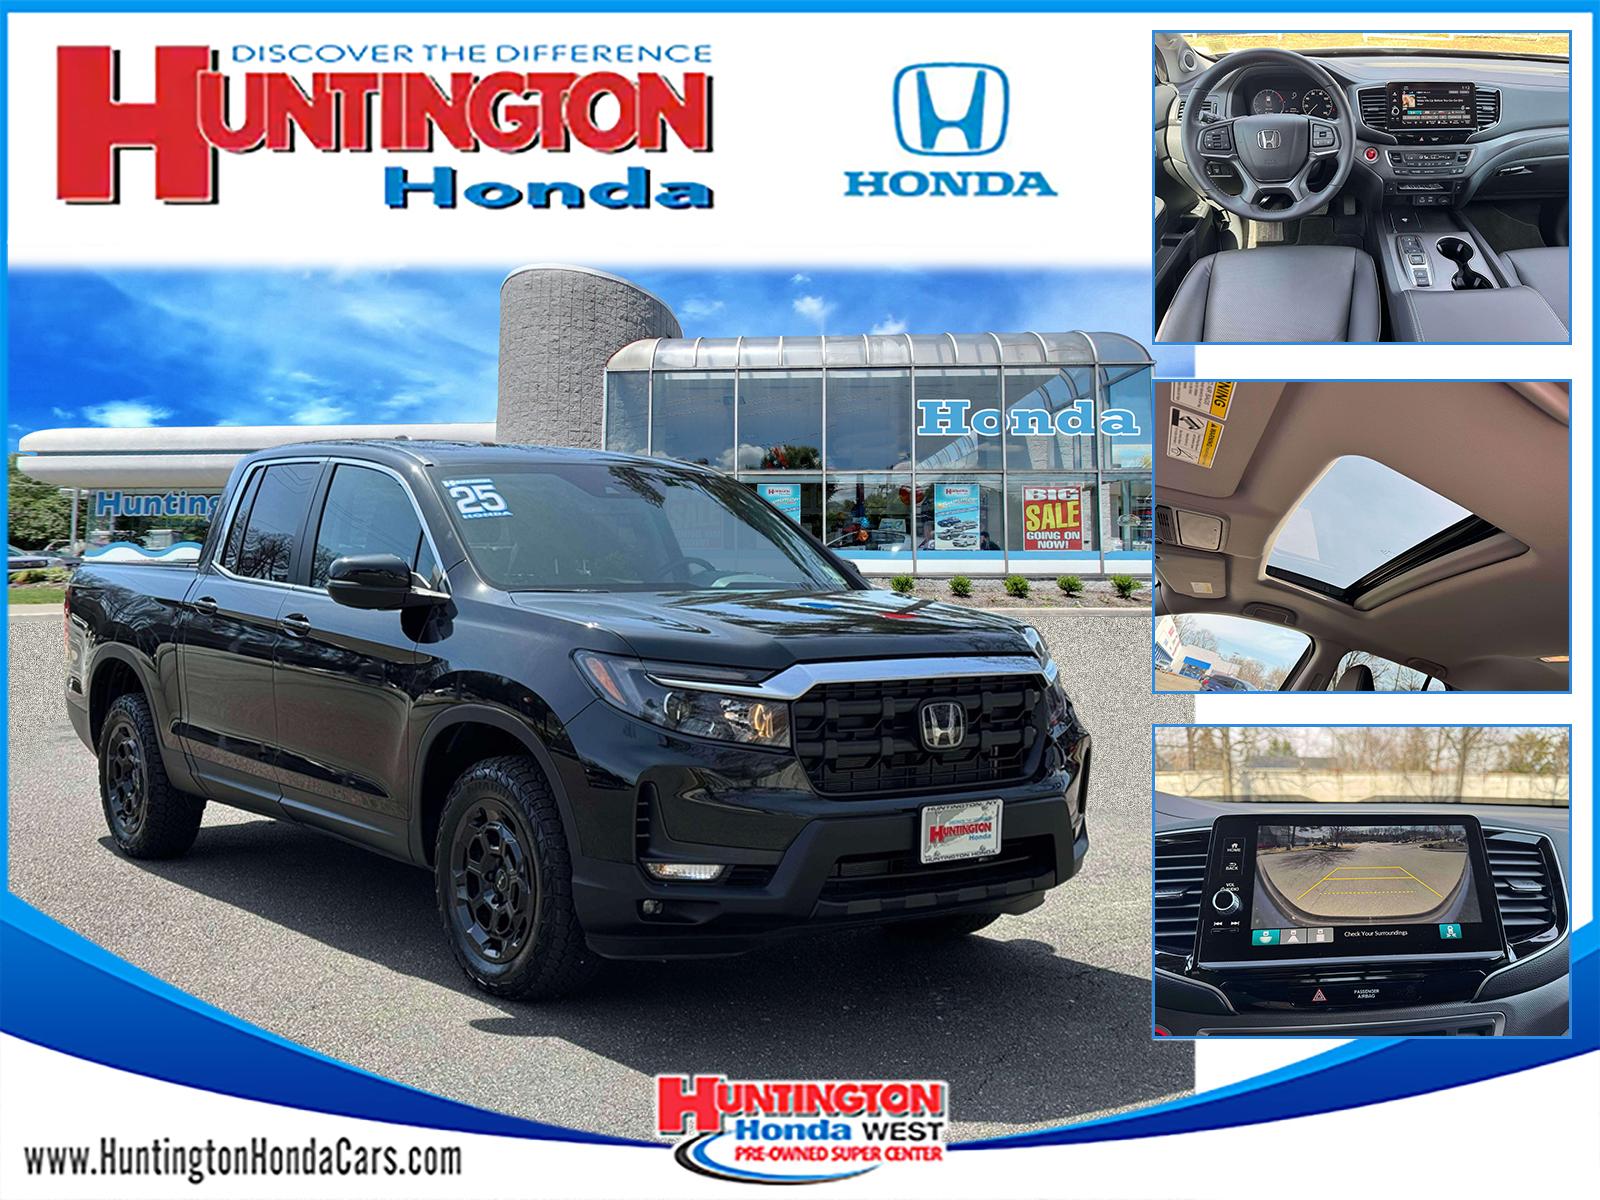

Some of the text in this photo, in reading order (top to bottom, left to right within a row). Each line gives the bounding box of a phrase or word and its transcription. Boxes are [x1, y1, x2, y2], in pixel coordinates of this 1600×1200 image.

[917, 399, 1141, 436] Honda
[448, 484, 508, 514] 25
[1025, 488, 1079, 501] BIG
[1026, 500, 1080, 531] SALE
[1026, 531, 1080, 540] GOING ON
[1037, 540, 1069, 549] NOW!
[929, 822, 992, 843] HUNTINGTON
[968, 833, 992, 841] Honda
[925, 852, 970, 862] HUNTINGTON
